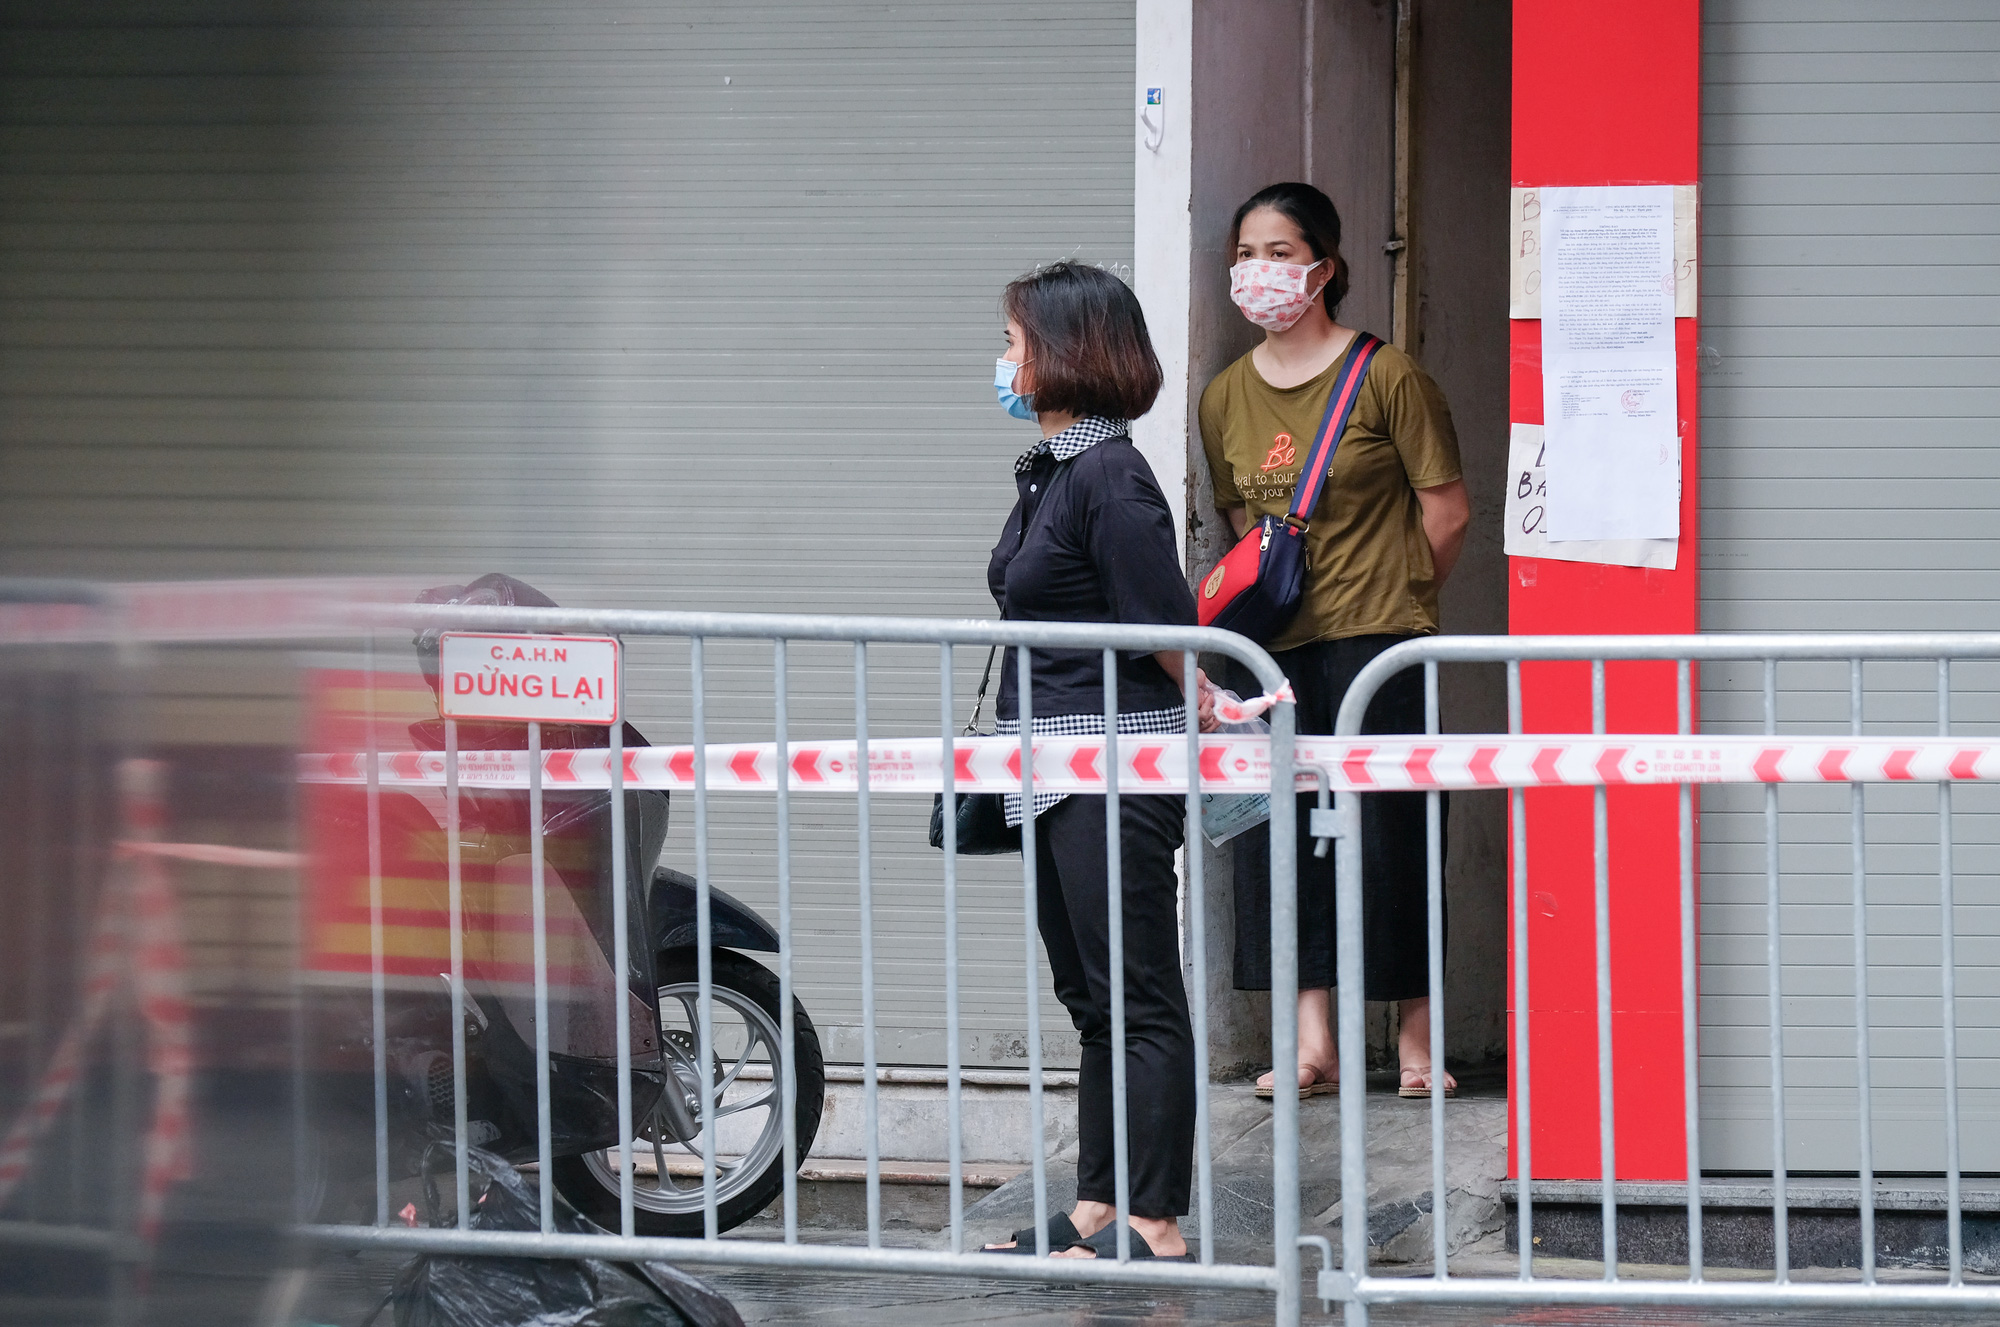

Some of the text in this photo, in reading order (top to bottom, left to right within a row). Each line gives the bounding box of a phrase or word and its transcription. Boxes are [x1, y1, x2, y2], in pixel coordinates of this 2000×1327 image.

[1260, 432, 1296, 473] Be
[1255, 473, 1268, 485] to
[1273, 472, 1295, 484] tour
[1261, 488, 1284, 501] your
[490, 645, 567, 662] C.A.H.N
[454, 664, 603, 705] DỪNG LẠI
